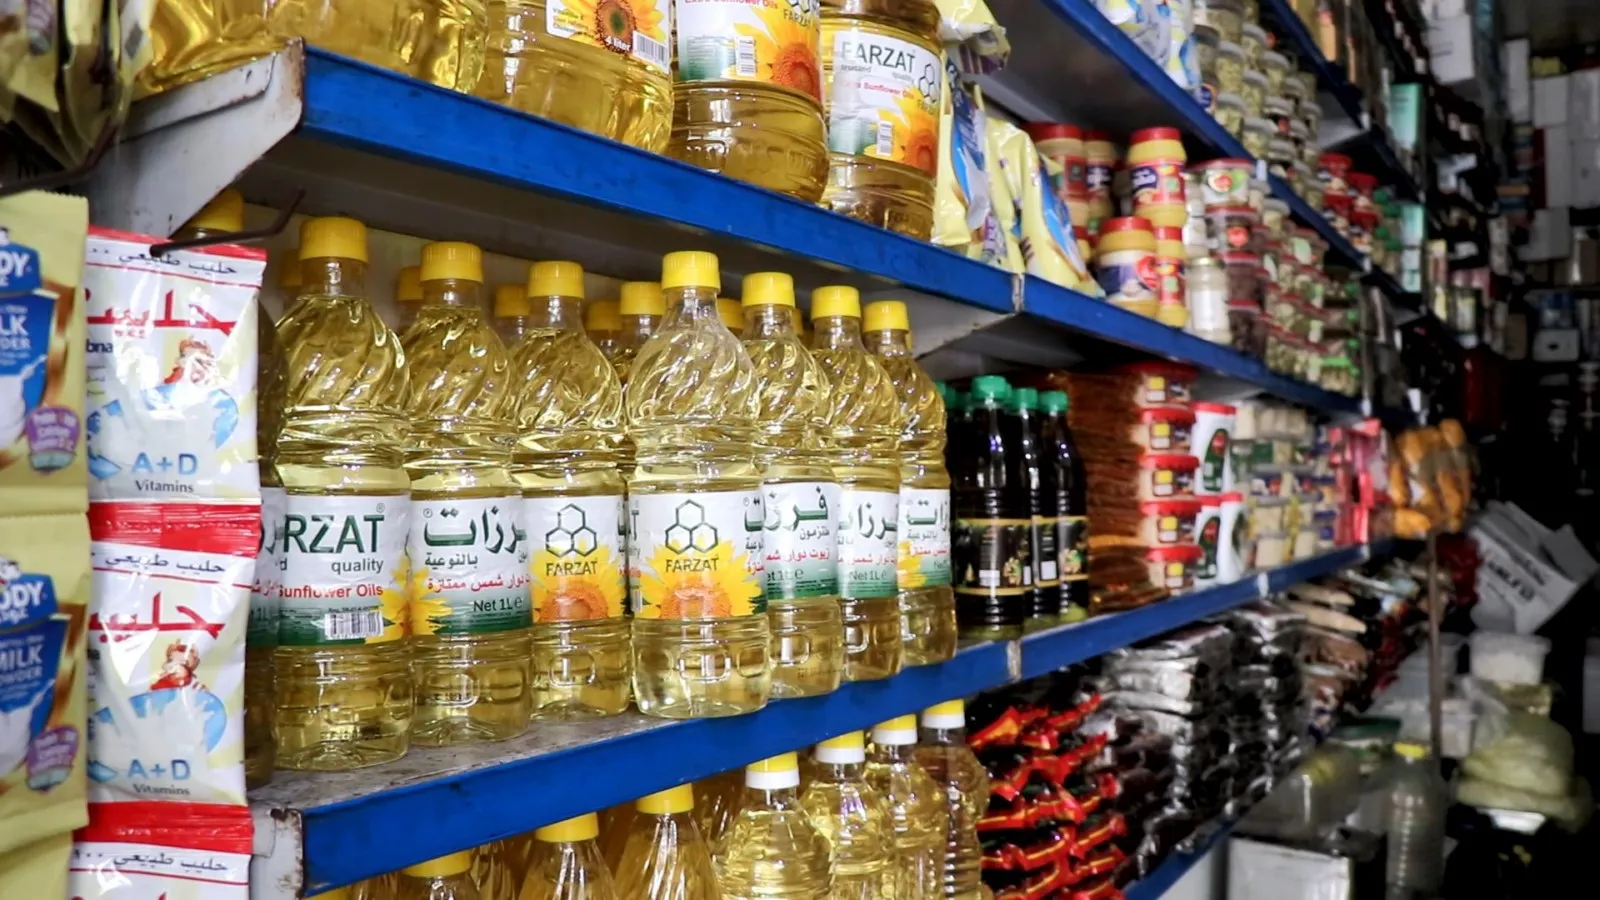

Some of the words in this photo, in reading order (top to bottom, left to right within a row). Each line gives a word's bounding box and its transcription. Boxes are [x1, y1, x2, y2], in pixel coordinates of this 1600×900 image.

[841, 41, 916, 73] FARZAT
[188, 261, 237, 276] حليب
[134, 480, 195, 496] Vitamins
[177, 559, 226, 576] حليب
[331, 559, 385, 576] quality
[425, 552, 479, 571] بالنوعية
[546, 561, 598, 577] FARZAT
[666, 558, 719, 575] FARZAT
[356, 583, 384, 598] Oils
[473, 600, 496, 612] Net
[132, 784, 191, 797] Vitamins
[113, 853, 174, 869] طبيعي
[180, 858, 228, 873] حليب
